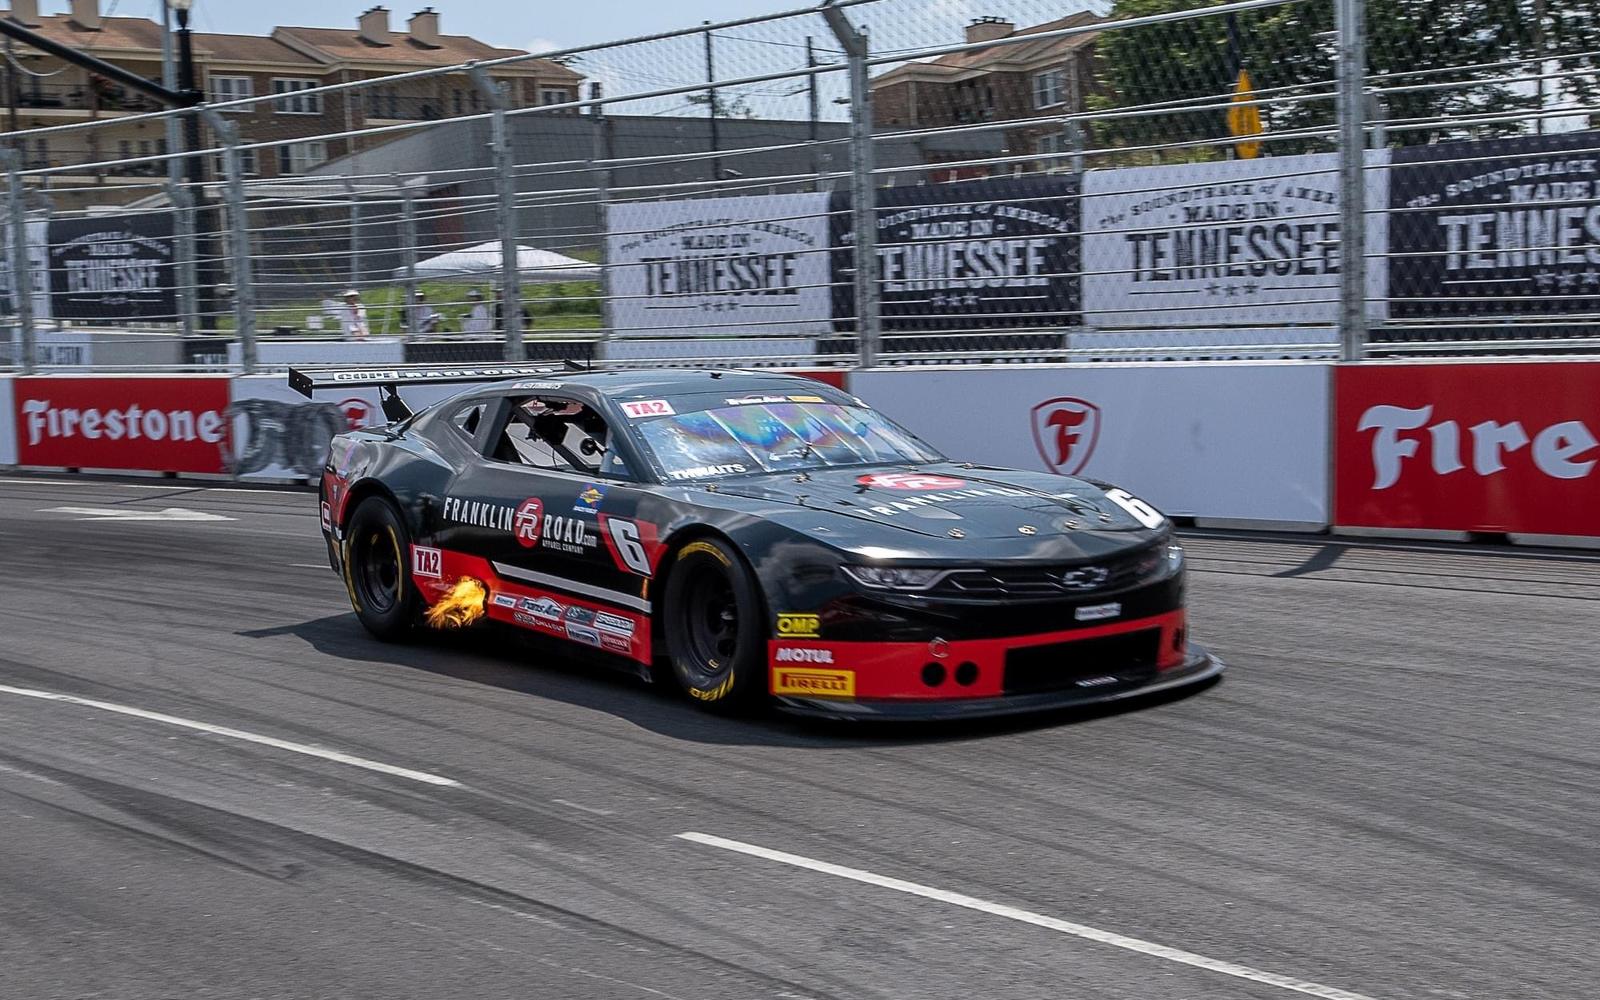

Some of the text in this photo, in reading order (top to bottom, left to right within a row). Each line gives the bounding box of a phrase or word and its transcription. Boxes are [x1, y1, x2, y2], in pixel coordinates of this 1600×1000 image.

[1445, 159, 1597, 198] SOUNDTRACK
[1508, 181, 1590, 203] MADE
[1130, 184, 1254, 216] SOUNDTRACK
[1284, 185, 1337, 204] AMER
[1183, 202, 1280, 223] MADE IN
[876, 204, 973, 229] OUNDTRACK
[911, 218, 994, 240] MADE IN
[1125, 223, 1341, 282] TENNESSEE
[640, 253, 798, 296] TENNESSEE
[22, 399, 224, 446] Firestone
[626, 401, 668, 416] TA2
[1046, 409, 1087, 465] F
[1357, 404, 1600, 490] Fire
[670, 463, 746, 480] THWAITS
[443, 497, 514, 532] FRANKLIN
[1105, 488, 1166, 529] 6
[608, 518, 652, 575] 6
[416, 550, 440, 574] TA2
[777, 618, 820, 633] OMP
[775, 647, 835, 664] MOTUL
[781, 673, 848, 691] PIRELLI
